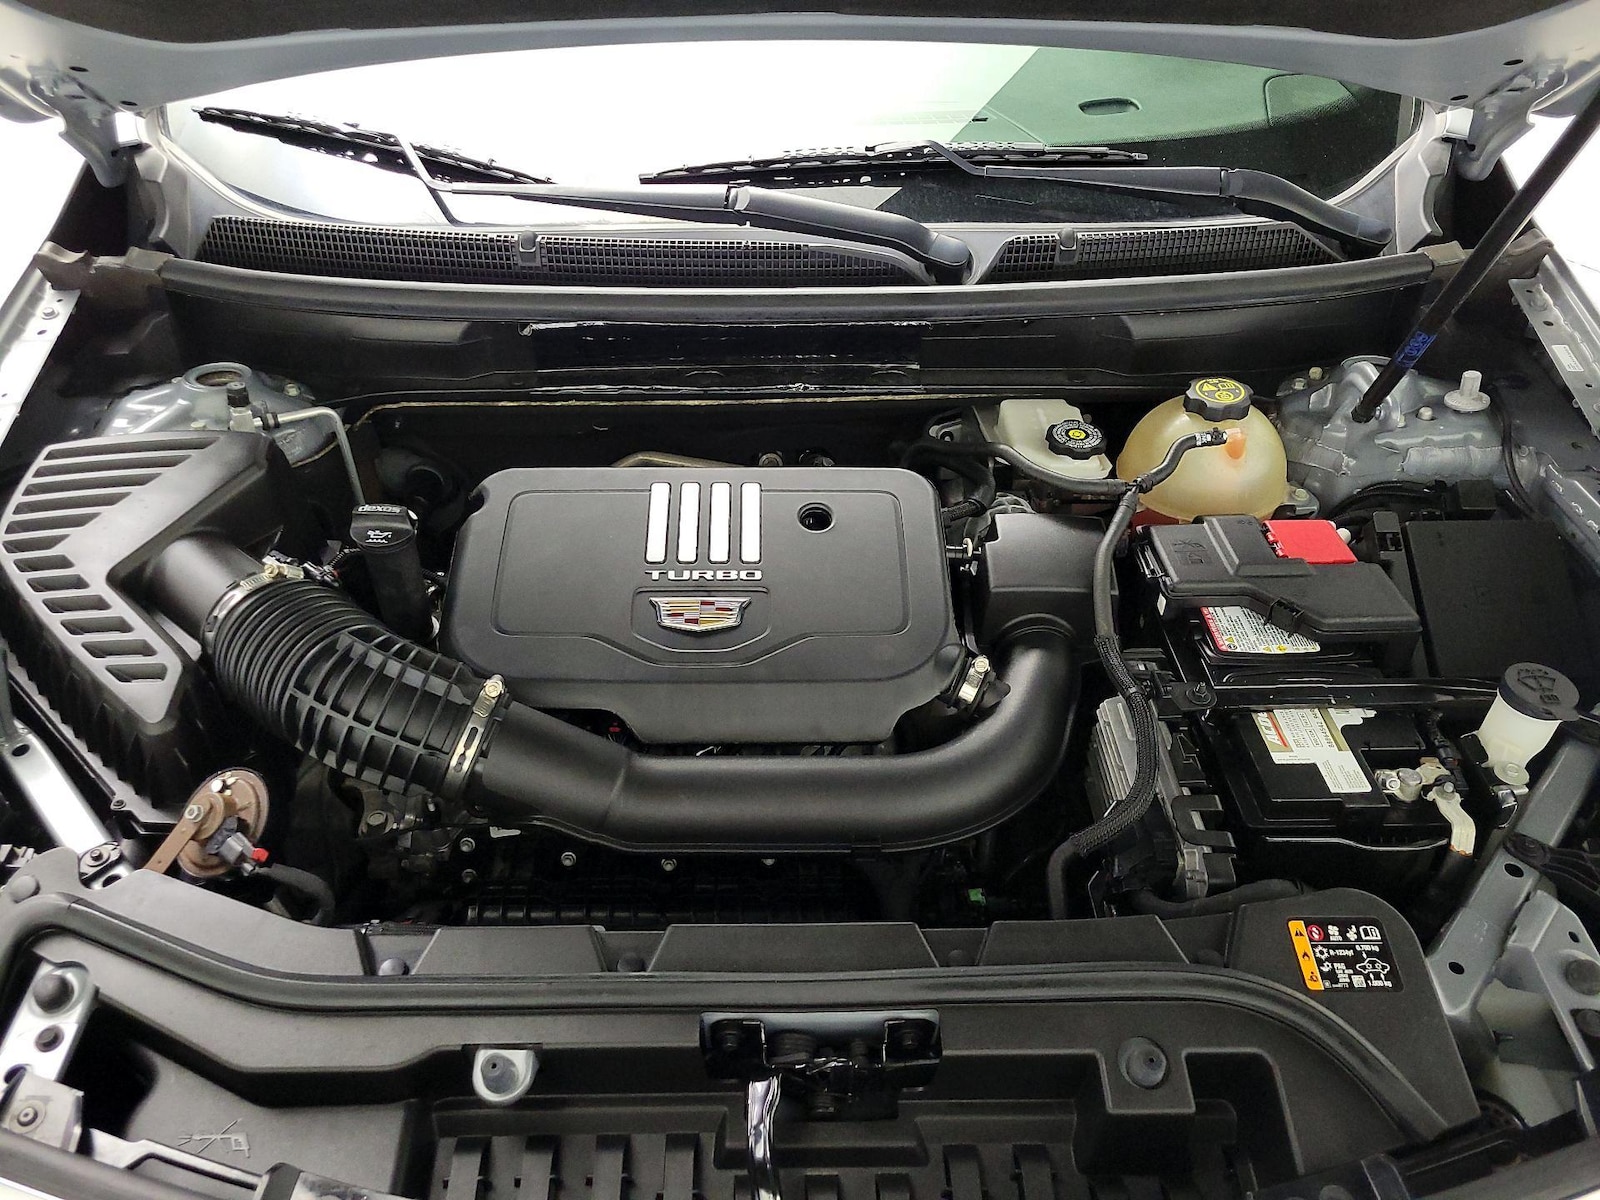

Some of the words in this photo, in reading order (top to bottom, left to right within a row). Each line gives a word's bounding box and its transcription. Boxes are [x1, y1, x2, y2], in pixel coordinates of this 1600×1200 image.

[357, 504, 402, 513] dexos
[644, 569, 763, 581] TURBO
[1257, 711, 1284, 746] ACDe
